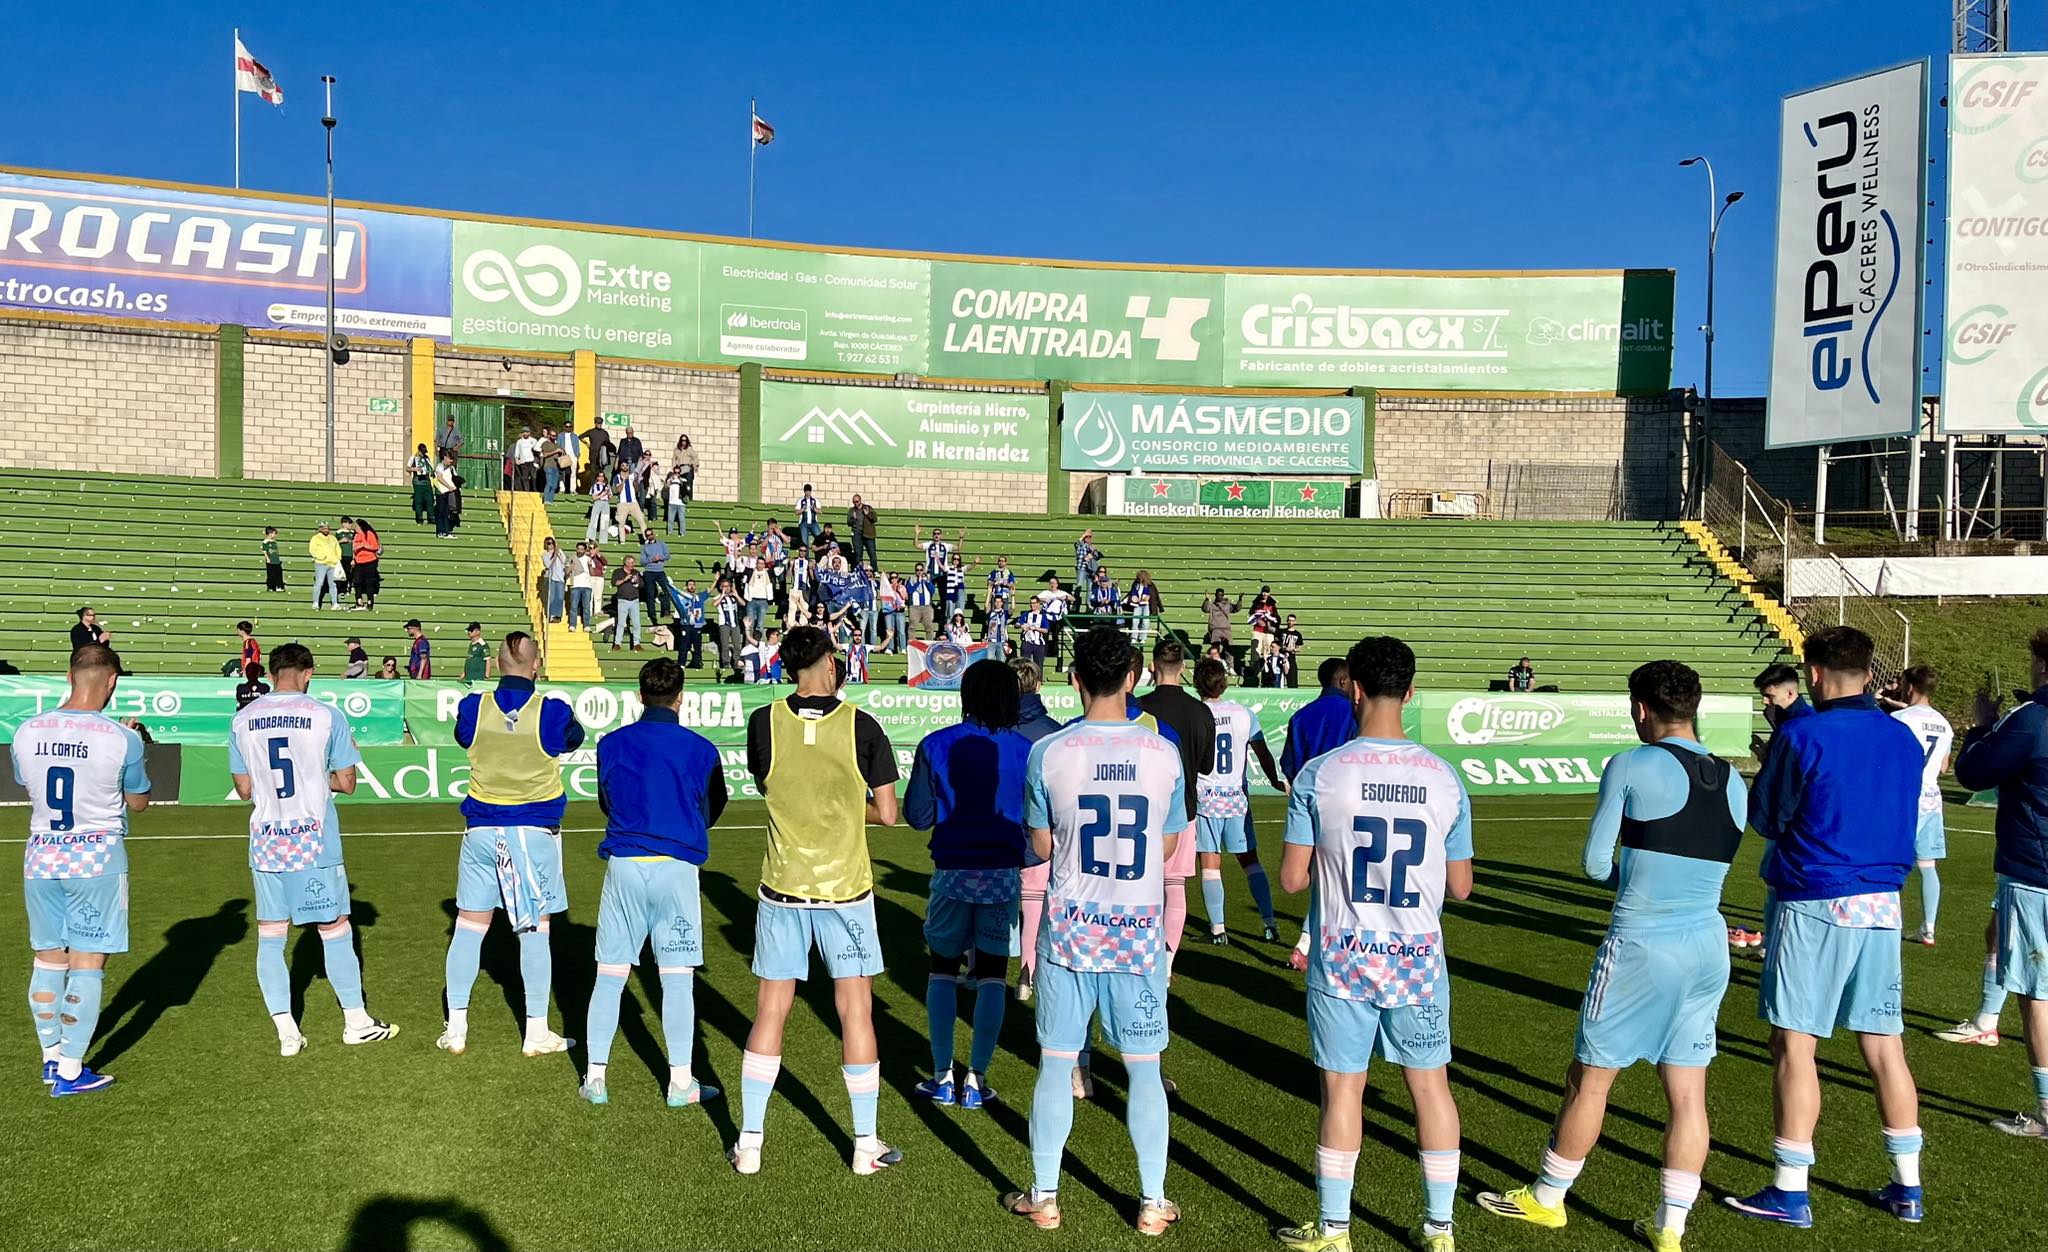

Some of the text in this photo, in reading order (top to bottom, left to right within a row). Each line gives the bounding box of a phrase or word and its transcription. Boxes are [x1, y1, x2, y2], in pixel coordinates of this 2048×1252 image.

[1963, 81, 2038, 108] CSIF
[1861, 103, 1880, 213] WELLNESS
[588, 259, 672, 291] Extre
[722, 265, 918, 290] Electricidad Gas Comunidad Solar
[587, 288, 672, 312] Marketing
[952, 287, 1088, 323] COMPRA
[291, 310, 337, 322] Emprea
[369, 318, 426, 330] extremeña
[750, 316, 801, 331] Iberdrola
[1241, 293, 1465, 350] Crisbaex
[1567, 318, 1664, 341] climalit
[462, 317, 673, 348] gestionamos tu energía
[943, 323, 1133, 360] LAENTRADA
[1958, 323, 2016, 345] CSIF
[727, 341, 801, 354] Agente colaborador
[846, 353, 864, 363] 927
[865, 355, 878, 364] 62
[878, 355, 891, 364] 53
[893, 356, 900, 365] 11
[1240, 359, 1508, 374] Fabricante de dobles acristalamientos
[907, 400, 1030, 420] Carpintería Hierro,
[1131, 399, 1351, 436] MÁSMEDIO
[920, 419, 1018, 437] Aluminio y PVC
[906, 440, 1030, 463] JR Hernández
[1131, 440, 1350, 453] CONSORCIO MEDIOAMBIENTE
[1131, 454, 1349, 467] Y AGUAS PROVINCIA DE CÁCERES
[1124, 502, 1197, 516] Heineken
[1200, 503, 1271, 518] Heineken
[1273, 505, 1341, 519] Heineken
[620, 691, 745, 727] MRCA
[919, 715, 928, 727] y
[52, 742, 88, 759] CORTÉS
[1216, 732, 1233, 774] 8
[1339, 752, 1382, 765] CAJA
[1919, 735, 1939, 768] 7
[268, 737, 296, 799] 5
[1094, 760, 1136, 781] JORRÍN
[1460, 757, 1612, 785] SATEL
[46, 766, 75, 831] 9
[1361, 783, 1427, 804] ESQUERDO
[42, 834, 102, 845] VALCARCE
[273, 823, 318, 836] VALCARC
[1078, 794, 1150, 880] 23
[1352, 815, 1427, 908] 22
[1081, 912, 1152, 928] VALCARCE
[1359, 943, 1431, 958] VALCARCE
